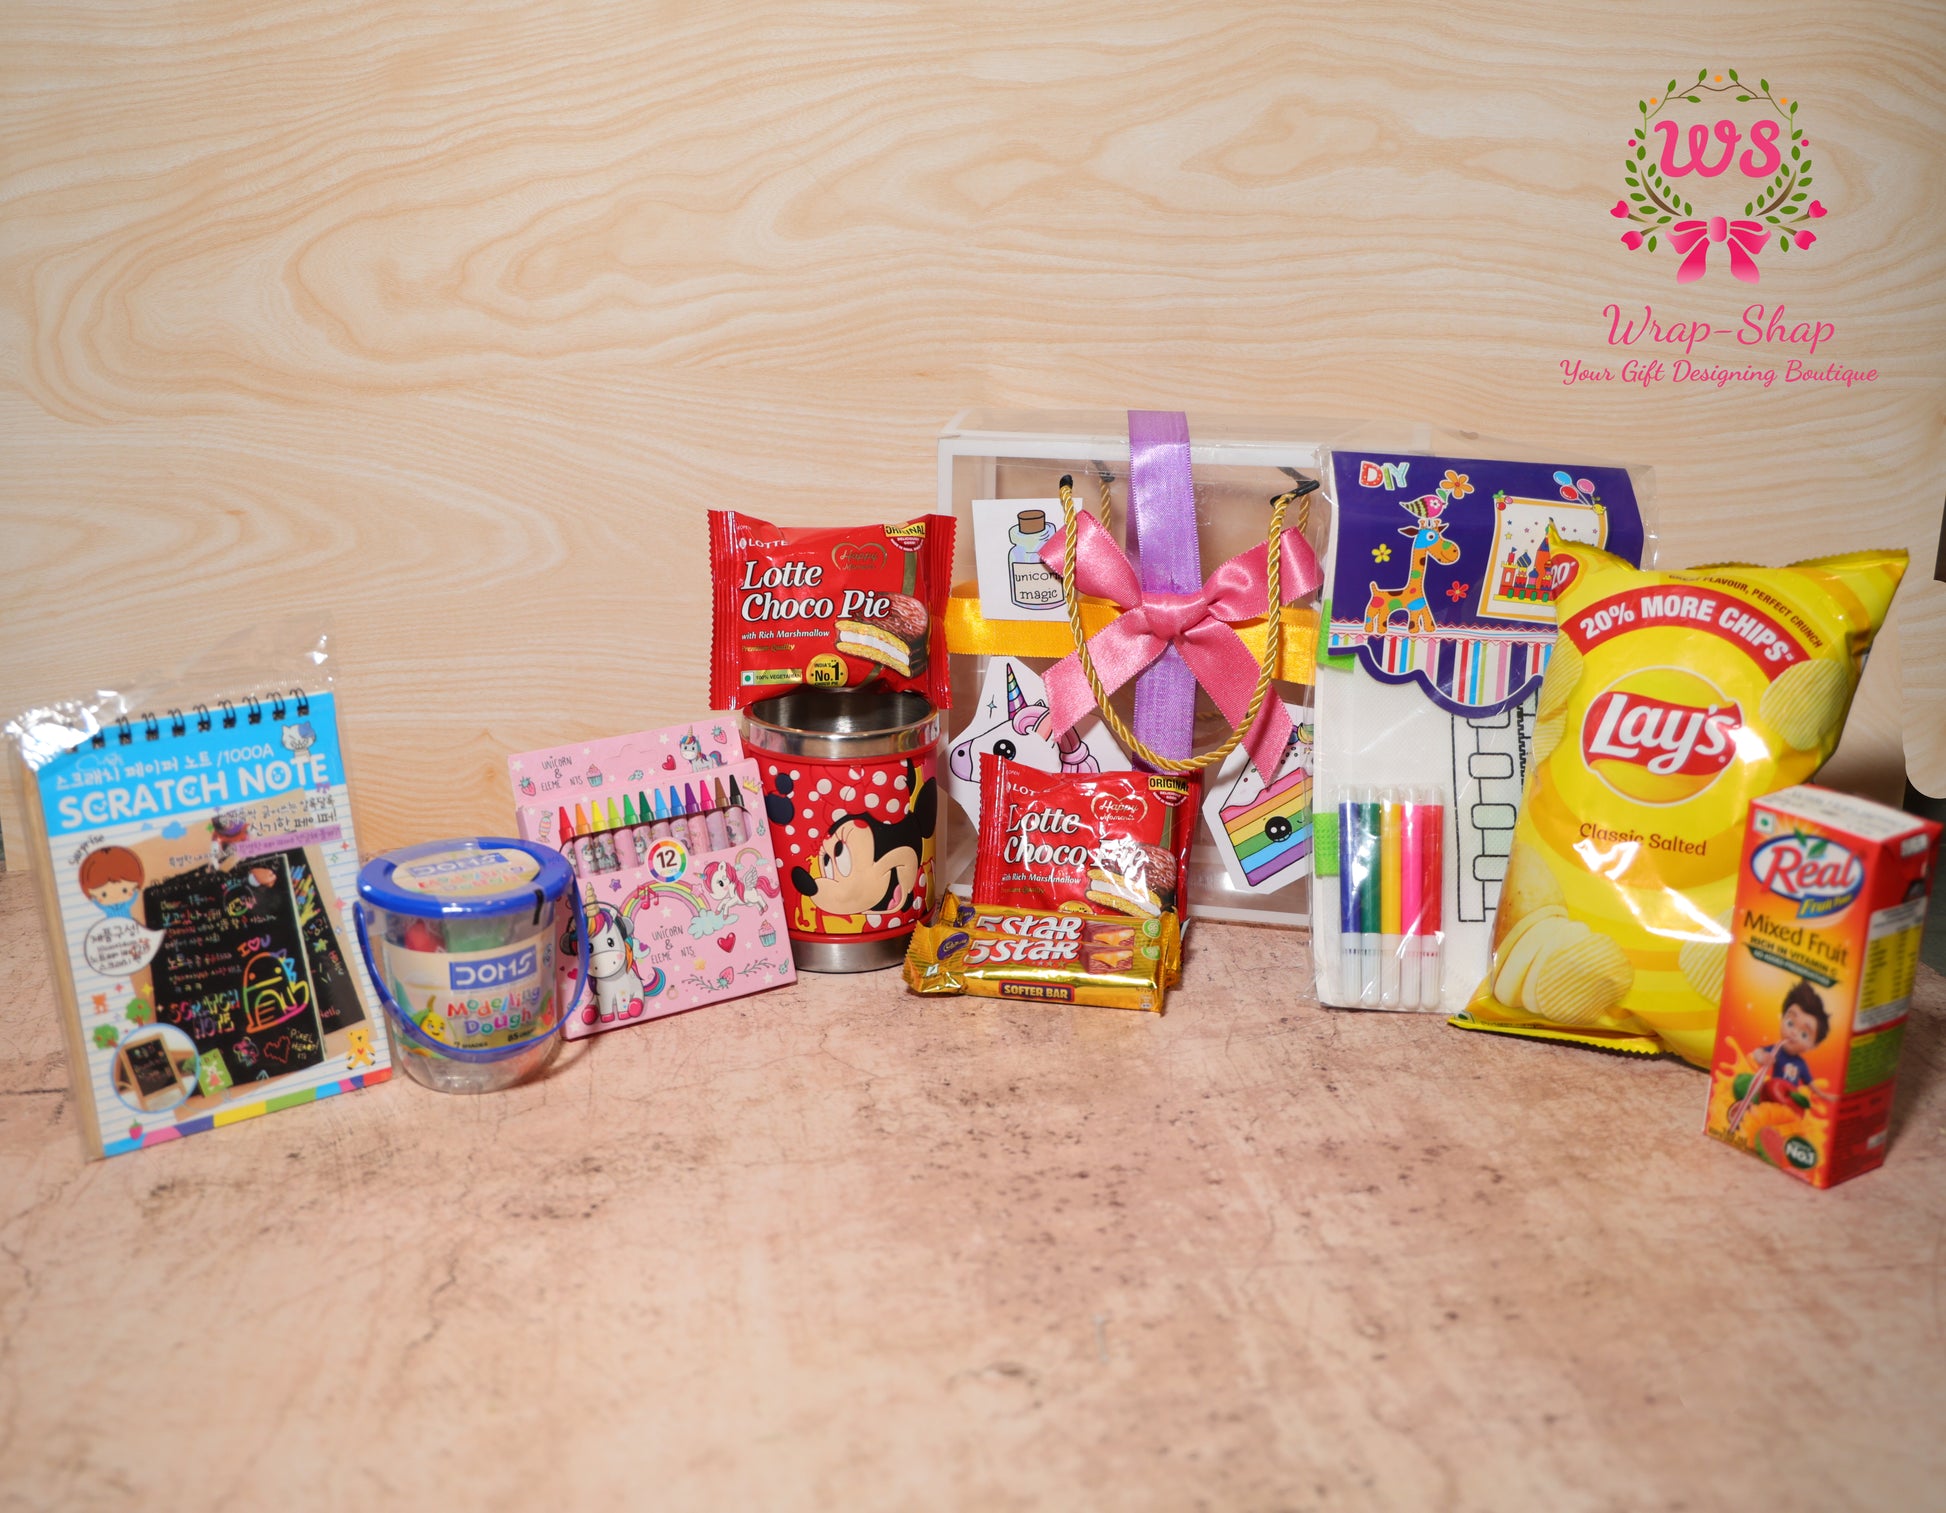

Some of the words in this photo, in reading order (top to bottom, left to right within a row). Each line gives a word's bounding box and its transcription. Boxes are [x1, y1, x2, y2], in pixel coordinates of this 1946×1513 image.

[1359, 460, 1410, 491] DIY
[740, 560, 823, 591] Lotte
[741, 591, 834, 622] Choco
[837, 589, 891, 620] Pie
[1019, 587, 1058, 602] magic
[1580, 601, 1636, 640] 20%
[1640, 594, 1717, 623] MORE
[1752, 588, 1793, 617] PERFECT
[1790, 615, 1824, 648] CRUNCH
[742, 631, 757, 640] with
[758, 630, 775, 640] Rich
[776, 628, 830, 639] Marshmallow
[1588, 692, 1743, 776] Lay's
[125, 757, 180, 779] 페이퍼
[184, 754, 213, 770] 노트
[541, 755, 573, 770] UNICORN
[554, 768, 563, 779] &
[58, 769, 229, 829] SCRATCH
[238, 753, 330, 797] NOTE
[1099, 799, 1139, 813] Happy
[1005, 803, 1081, 834] Lotte
[1003, 835, 1089, 866] Choco
[1579, 822, 1645, 843] Classic
[1648, 833, 1707, 857] Salted
[656, 849, 678, 869] 12
[1760, 844, 1857, 894] Real
[1012, 872, 1027, 881] Rich
[651, 925, 684, 941] UNICORN
[664, 938, 674, 951] &
[1743, 909, 1804, 947] Mixed
[1808, 932, 1850, 967] Fruit
[455, 951, 533, 986] DOMS
[447, 986, 541, 1018] Modelling
[1003, 984, 1044, 997] SOFTER
[1045, 986, 1069, 999] BAR
[464, 1006, 532, 1036] Dough
